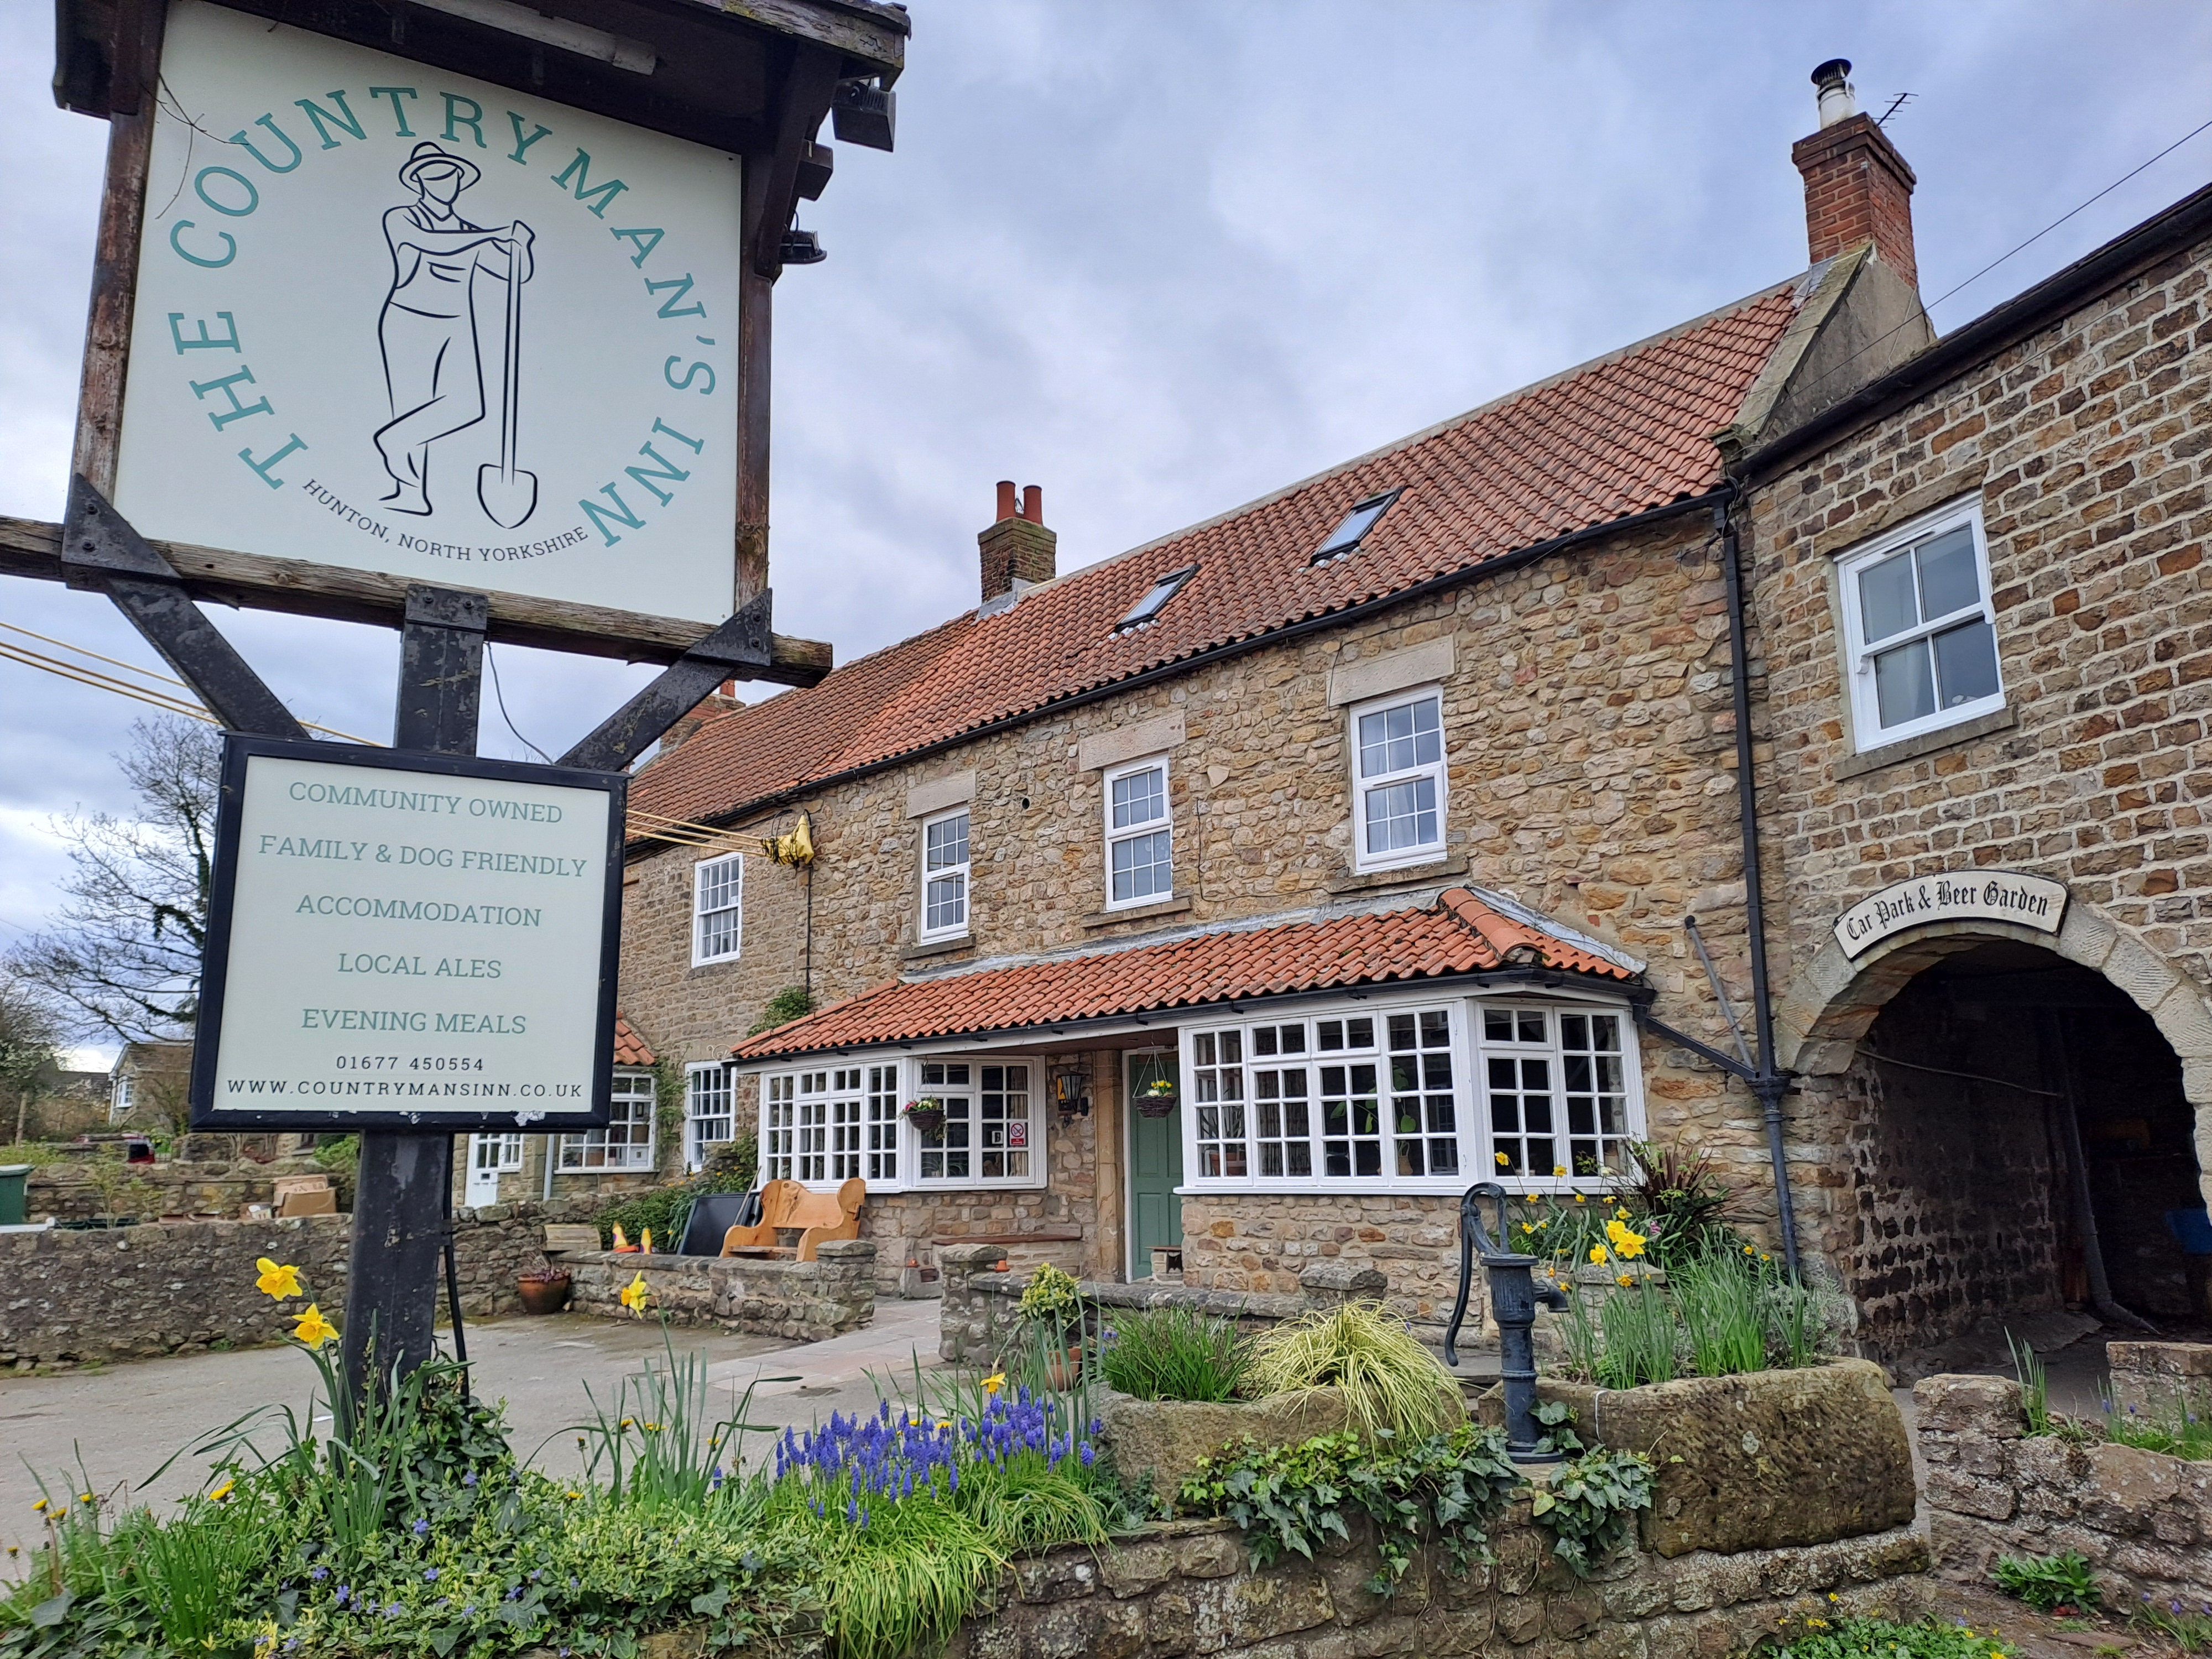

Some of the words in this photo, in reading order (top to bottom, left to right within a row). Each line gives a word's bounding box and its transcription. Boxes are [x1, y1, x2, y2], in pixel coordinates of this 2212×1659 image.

[169, 86, 717, 397] COUNTRYMAN'S
[167, 310, 309, 490] THE
[577, 416, 705, 547] INN
[301, 478, 392, 544] HUNTON,
[397, 533, 472, 561] NORTH
[478, 526, 588, 561] YORKSHIRE
[289, 782, 462, 815] COMMUNITY
[469, 799, 562, 823] OWNED
[258, 834, 369, 862] FAMILY
[375, 844, 392, 863] &
[398, 846, 453, 868] DOG
[460, 851, 587, 877] FRIENDLY
[295, 894, 542, 927] ACCOMMODATION
[1845, 916, 1873, 941] Car
[1872, 891, 1915, 930] Park
[1918, 885, 1932, 910] &
[1935, 880, 1978, 912] Beer
[1983, 880, 2049, 916] Garden
[337, 953, 427, 975] LOCAL
[434, 958, 502, 979] ALES
[301, 1009, 427, 1032] EVENING
[434, 1013, 526, 1035] MEALS
[336, 1055, 399, 1071] 01677
[409, 1057, 484, 1072] 450554
[227, 1079, 582, 1098] WWW.COUNTRYMANSINN.CO.UK
